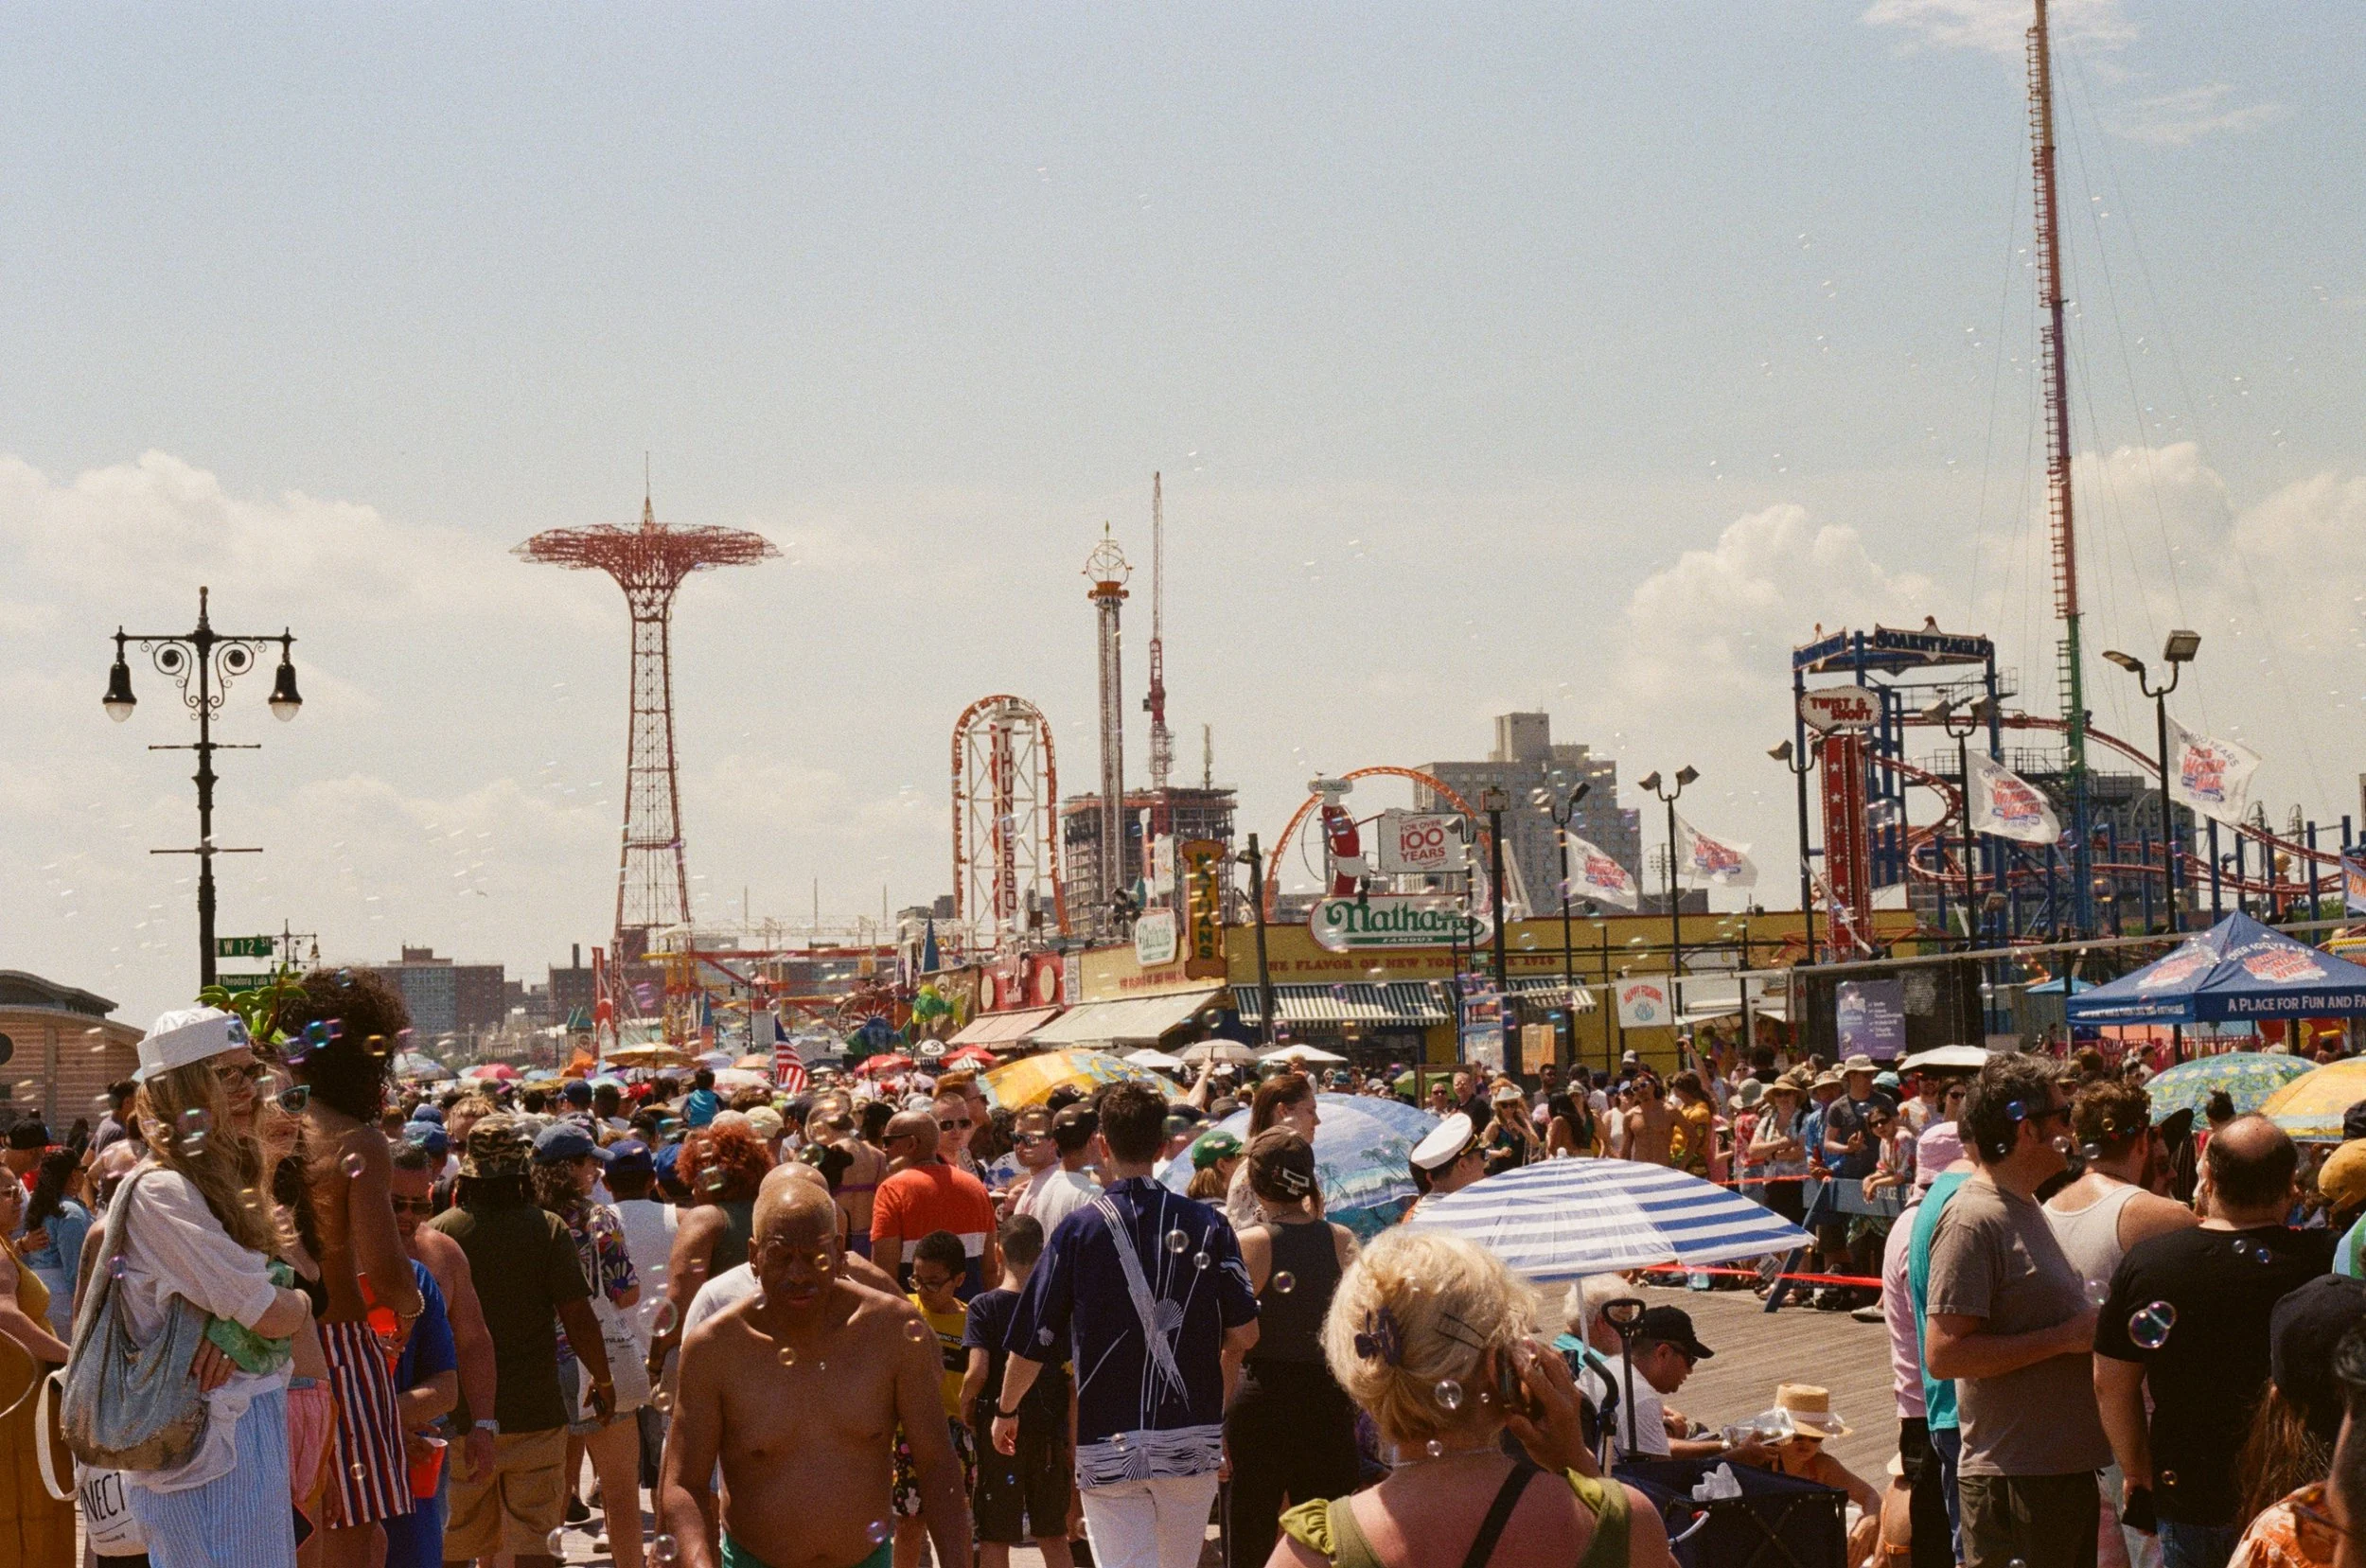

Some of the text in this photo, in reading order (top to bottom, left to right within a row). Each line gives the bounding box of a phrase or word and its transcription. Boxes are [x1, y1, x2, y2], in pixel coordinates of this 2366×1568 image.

[1810, 697, 1866, 710] TWIST &
[1830, 710, 1873, 721] SHOUT
[1000, 727, 1017, 933] THUNDERBOL
[1400, 819, 1442, 832] FOR OVER
[1400, 827, 1444, 851] 100
[1400, 846, 1446, 863] YEARS
[223, 939, 234, 955] W
[239, 939, 256, 955] 12
[2227, 945, 2251, 961] OVER
[1268, 960, 1289, 971] HE
[1295, 959, 1351, 971] FLAVOR
[1359, 959, 1379, 969] OF
[1386, 958, 1420, 969] NEW
[2228, 998, 2236, 1012] A
[2239, 998, 2275, 1012] PLACE
[2277, 996, 2299, 1010] FOR
[2302, 995, 2325, 1010] FUN
[2328, 995, 2353, 1009] AND
[79, 1471, 126, 1523] NECT
